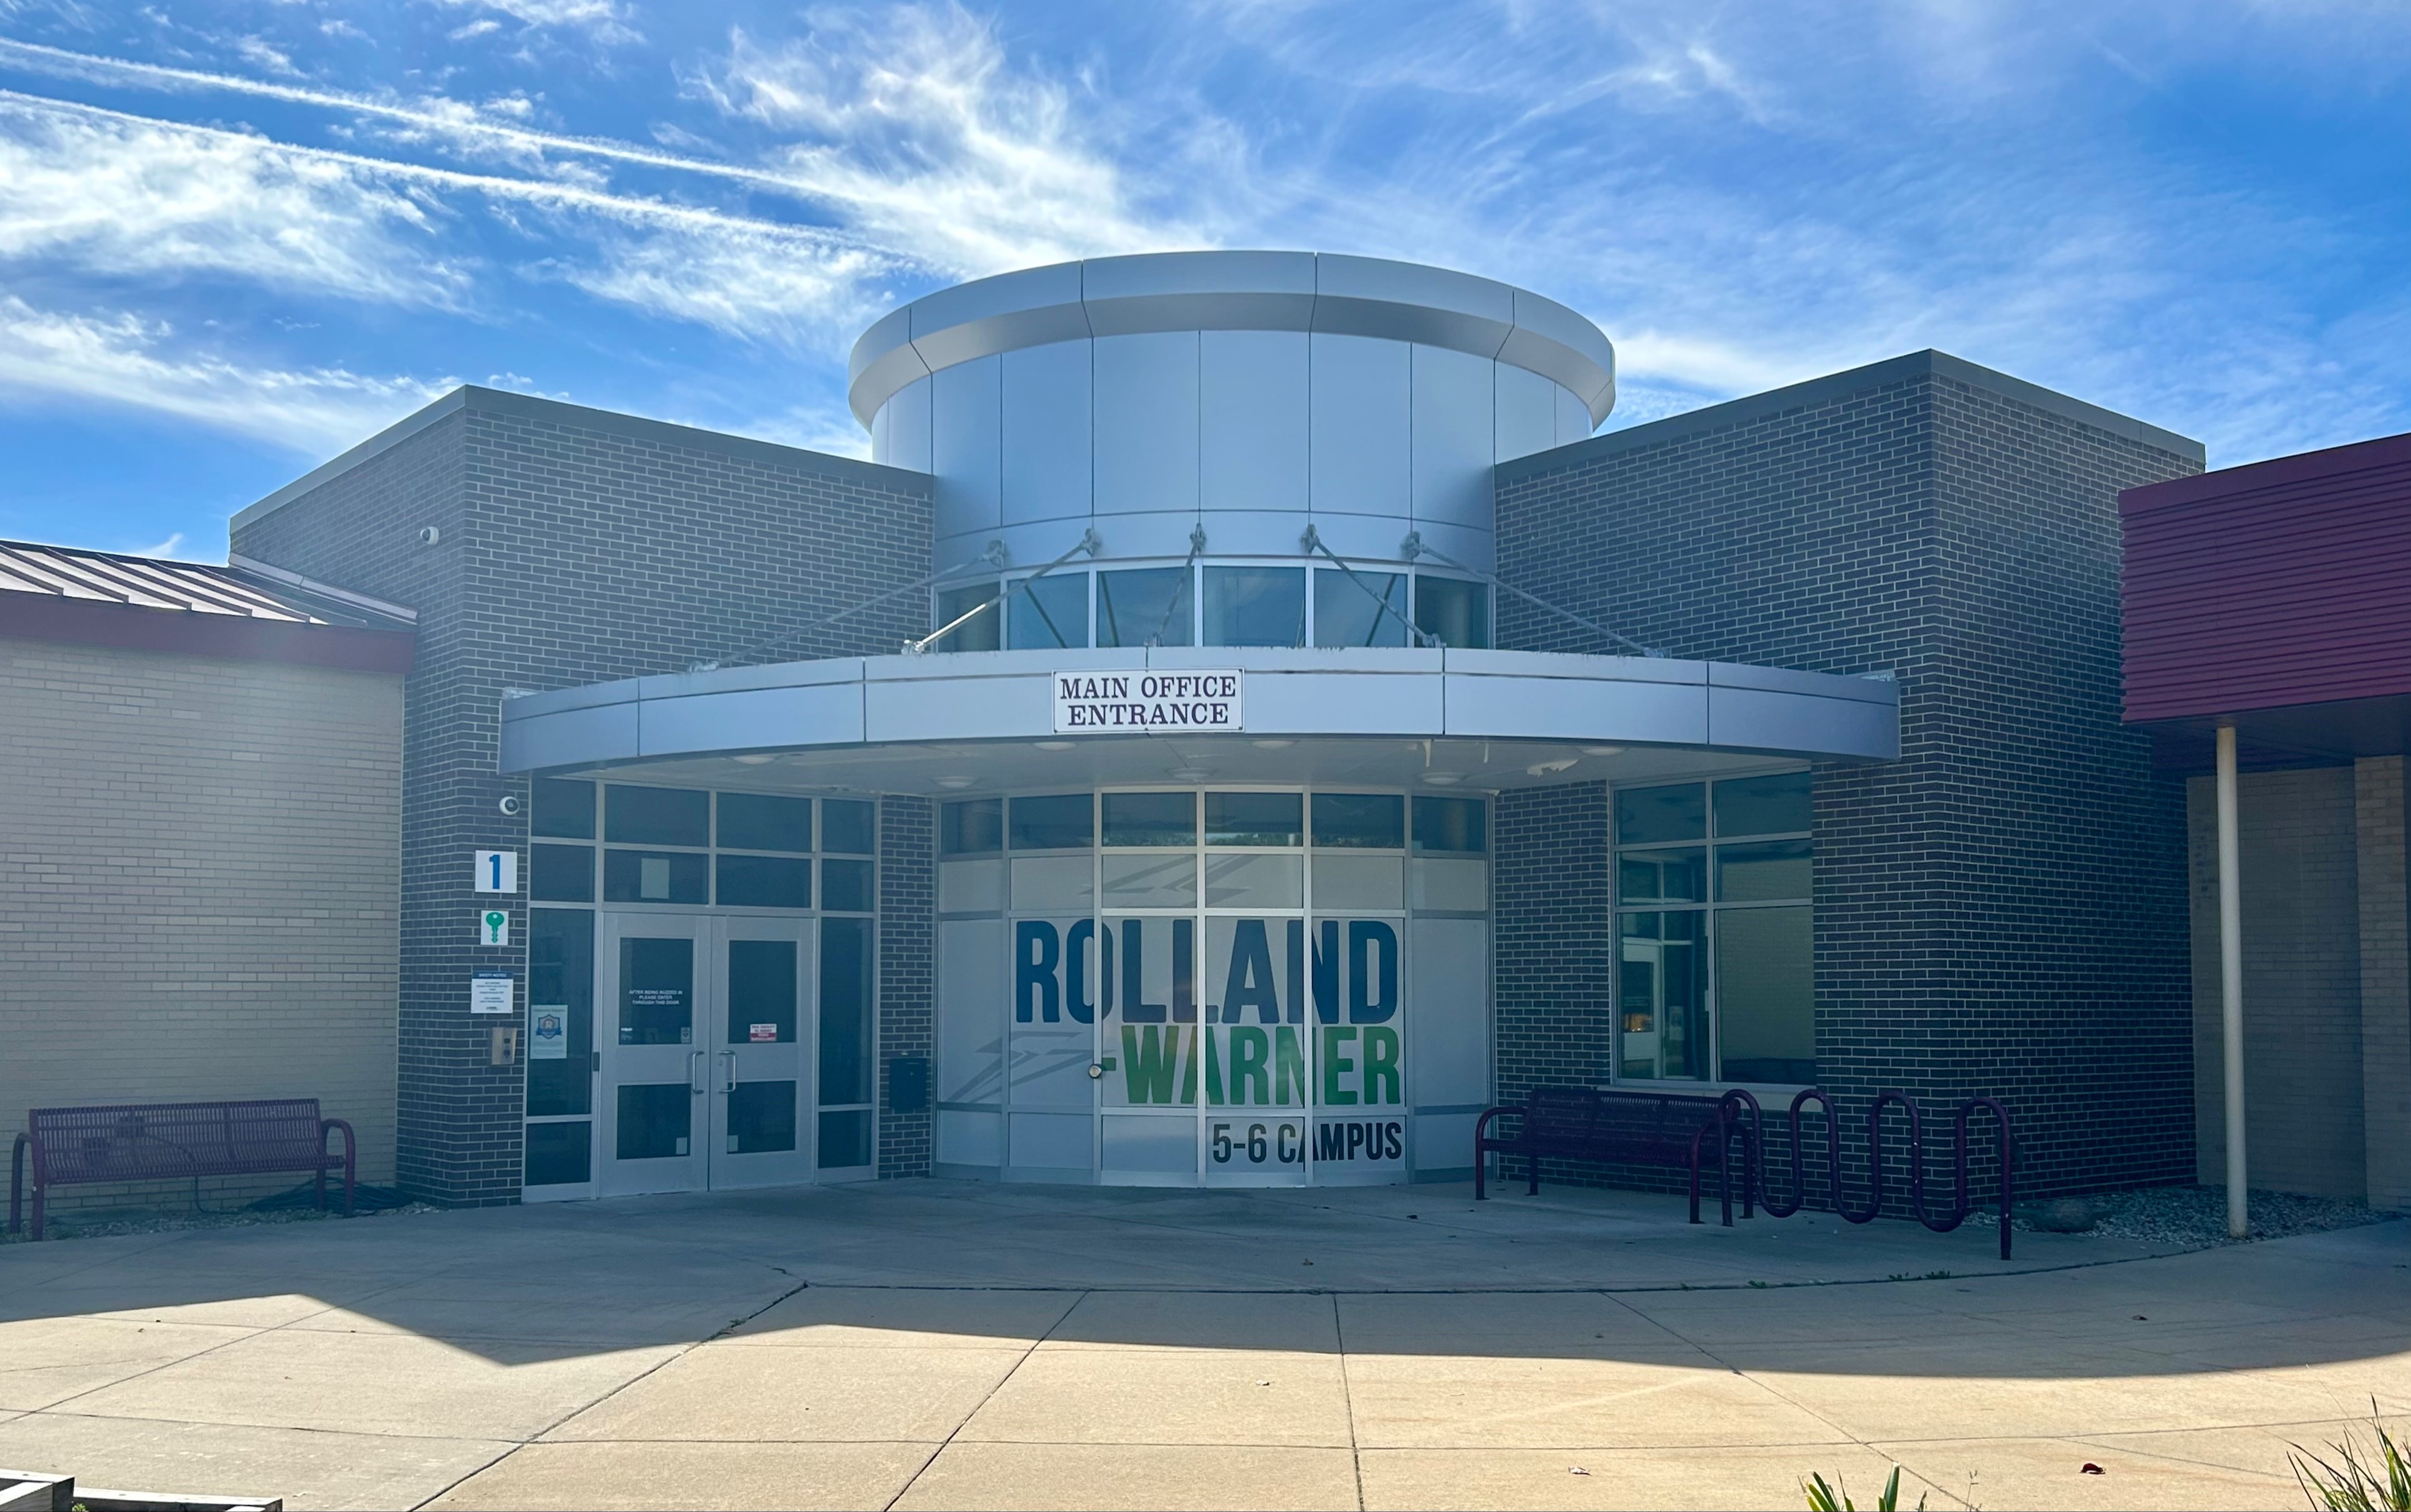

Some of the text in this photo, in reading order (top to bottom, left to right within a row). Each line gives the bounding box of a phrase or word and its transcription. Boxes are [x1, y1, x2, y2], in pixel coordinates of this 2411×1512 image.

[1060, 675, 1236, 699] MAIN OFFICE
[1068, 702, 1229, 726] ENTRANCE
[489, 854, 500, 890] 1
[1016, 918, 1398, 1024] ROLLAND
[1213, 1122, 1402, 1163] 5-6 CAMPUS
